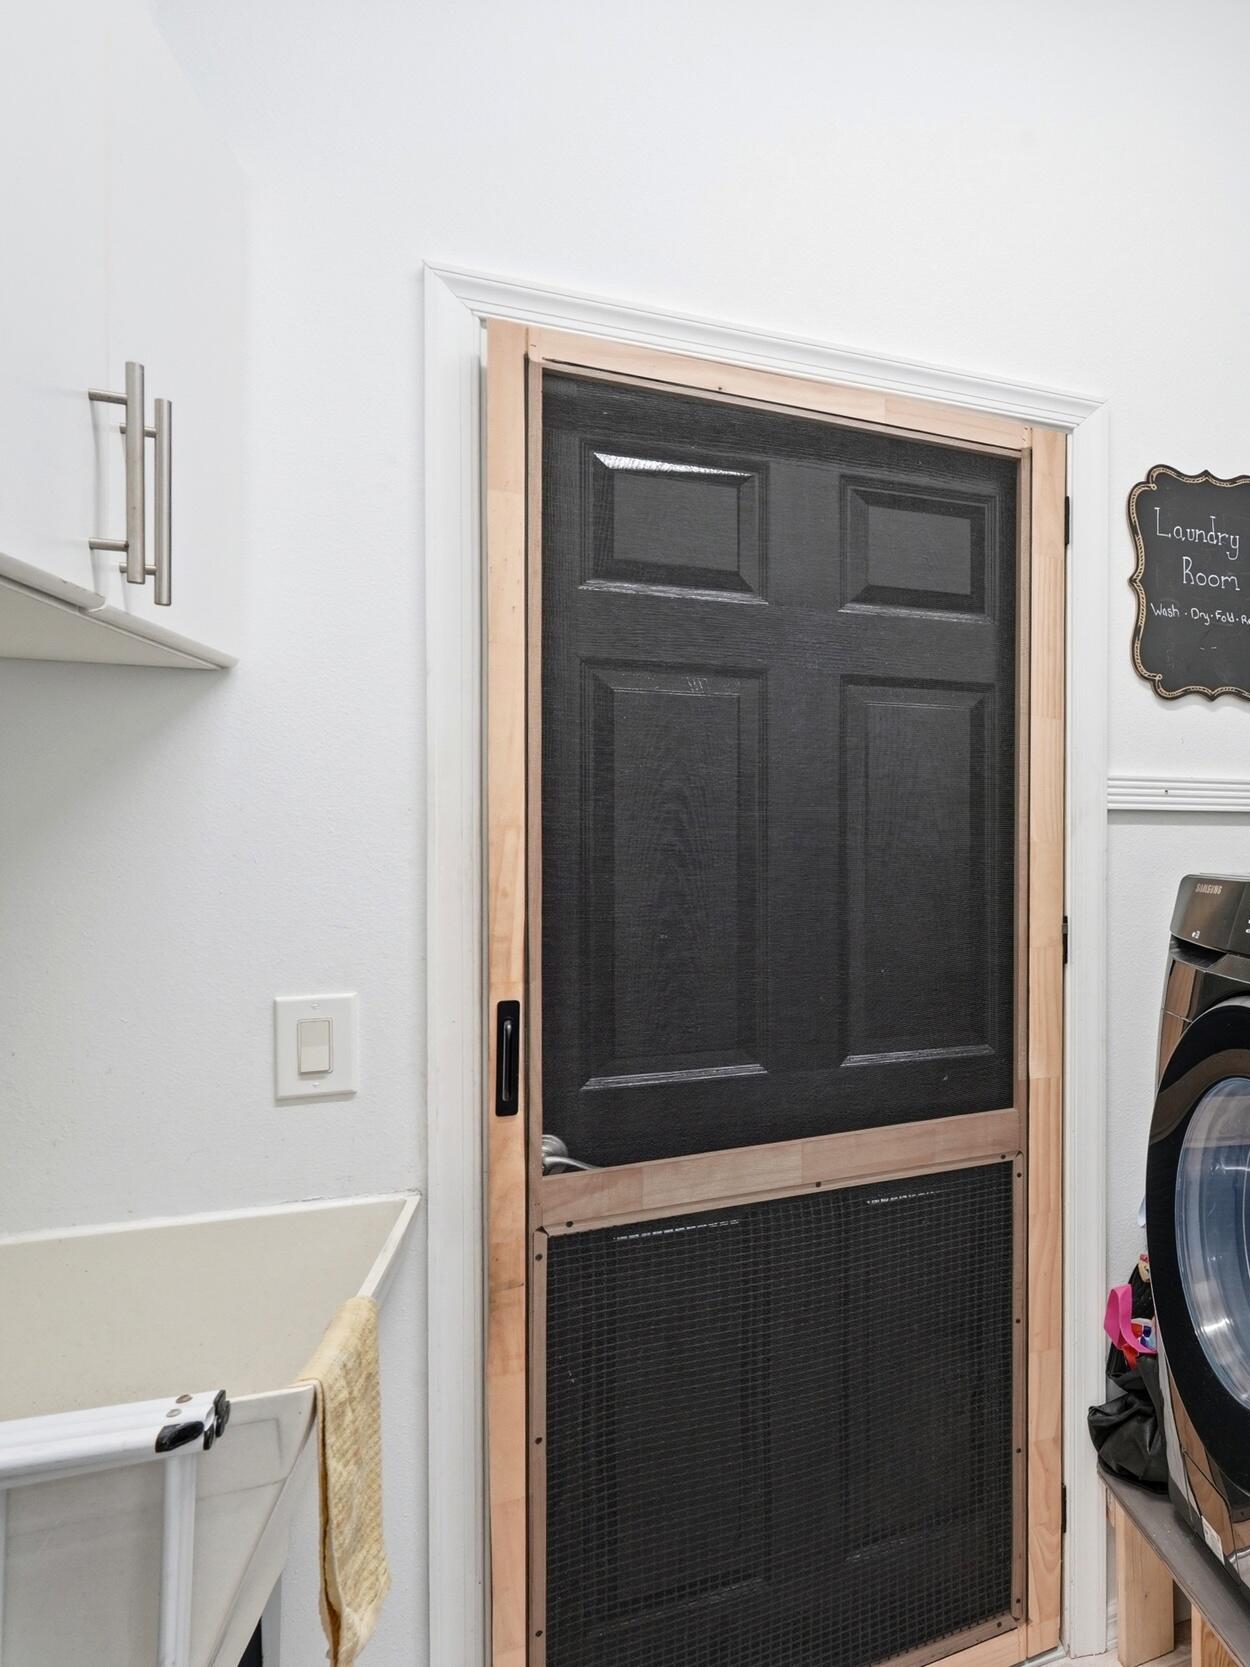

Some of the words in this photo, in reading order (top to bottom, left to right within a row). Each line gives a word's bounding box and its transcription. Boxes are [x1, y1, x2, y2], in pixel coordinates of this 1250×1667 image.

[1154, 507, 1240, 560] Laundry
[1182, 556, 1240, 591] Room
[1150, 602, 1180, 617] Wash
[1190, 608, 1211, 626] Dry
[1215, 610, 1235, 623] Fold
[1195, 883, 1223, 894] SAMSUNG
